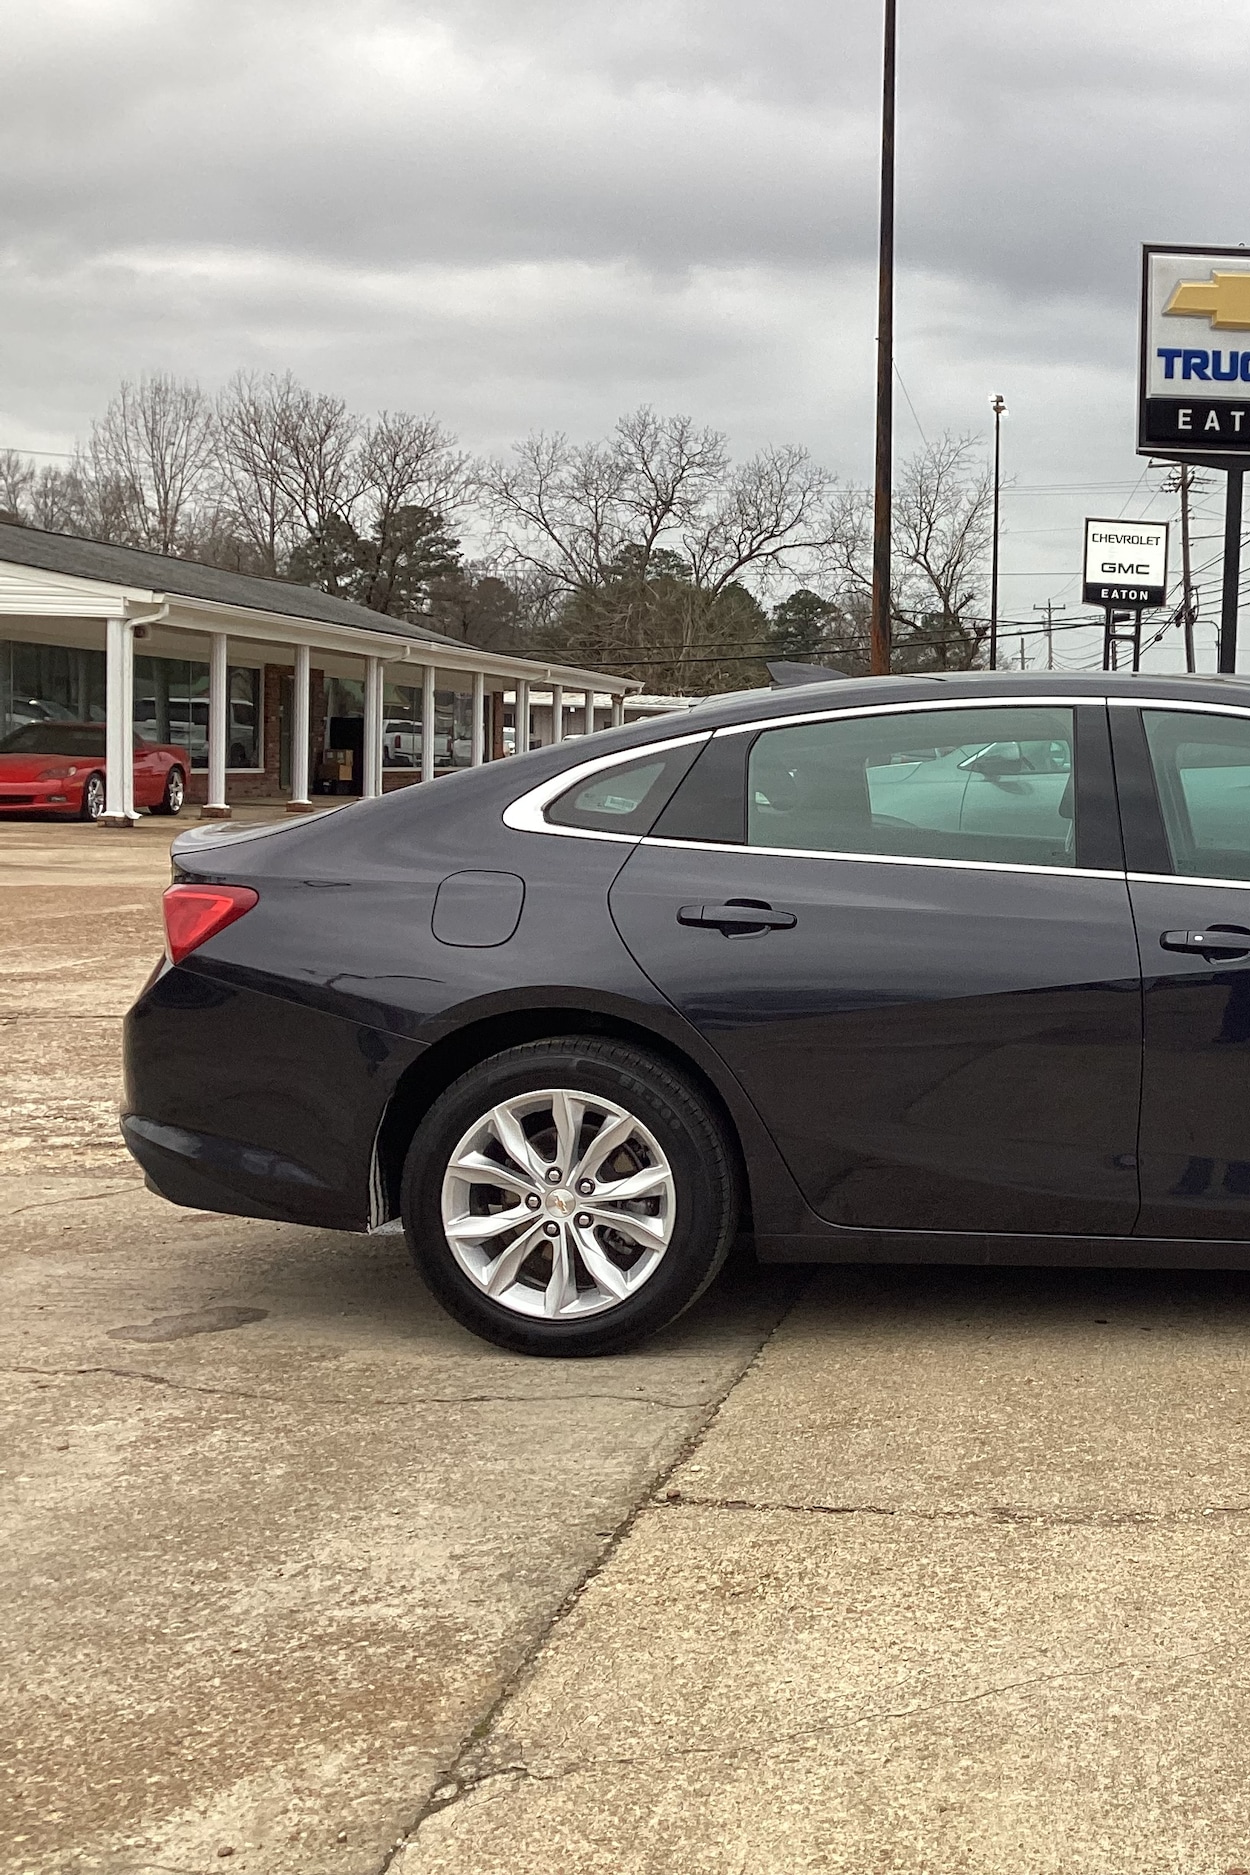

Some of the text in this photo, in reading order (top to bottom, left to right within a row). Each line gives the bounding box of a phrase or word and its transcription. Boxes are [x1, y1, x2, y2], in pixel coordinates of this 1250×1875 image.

[1092, 532, 1161, 546] CHEVROLET
[1101, 562, 1150, 575] GMC
[1101, 588, 1149, 601] EATON
